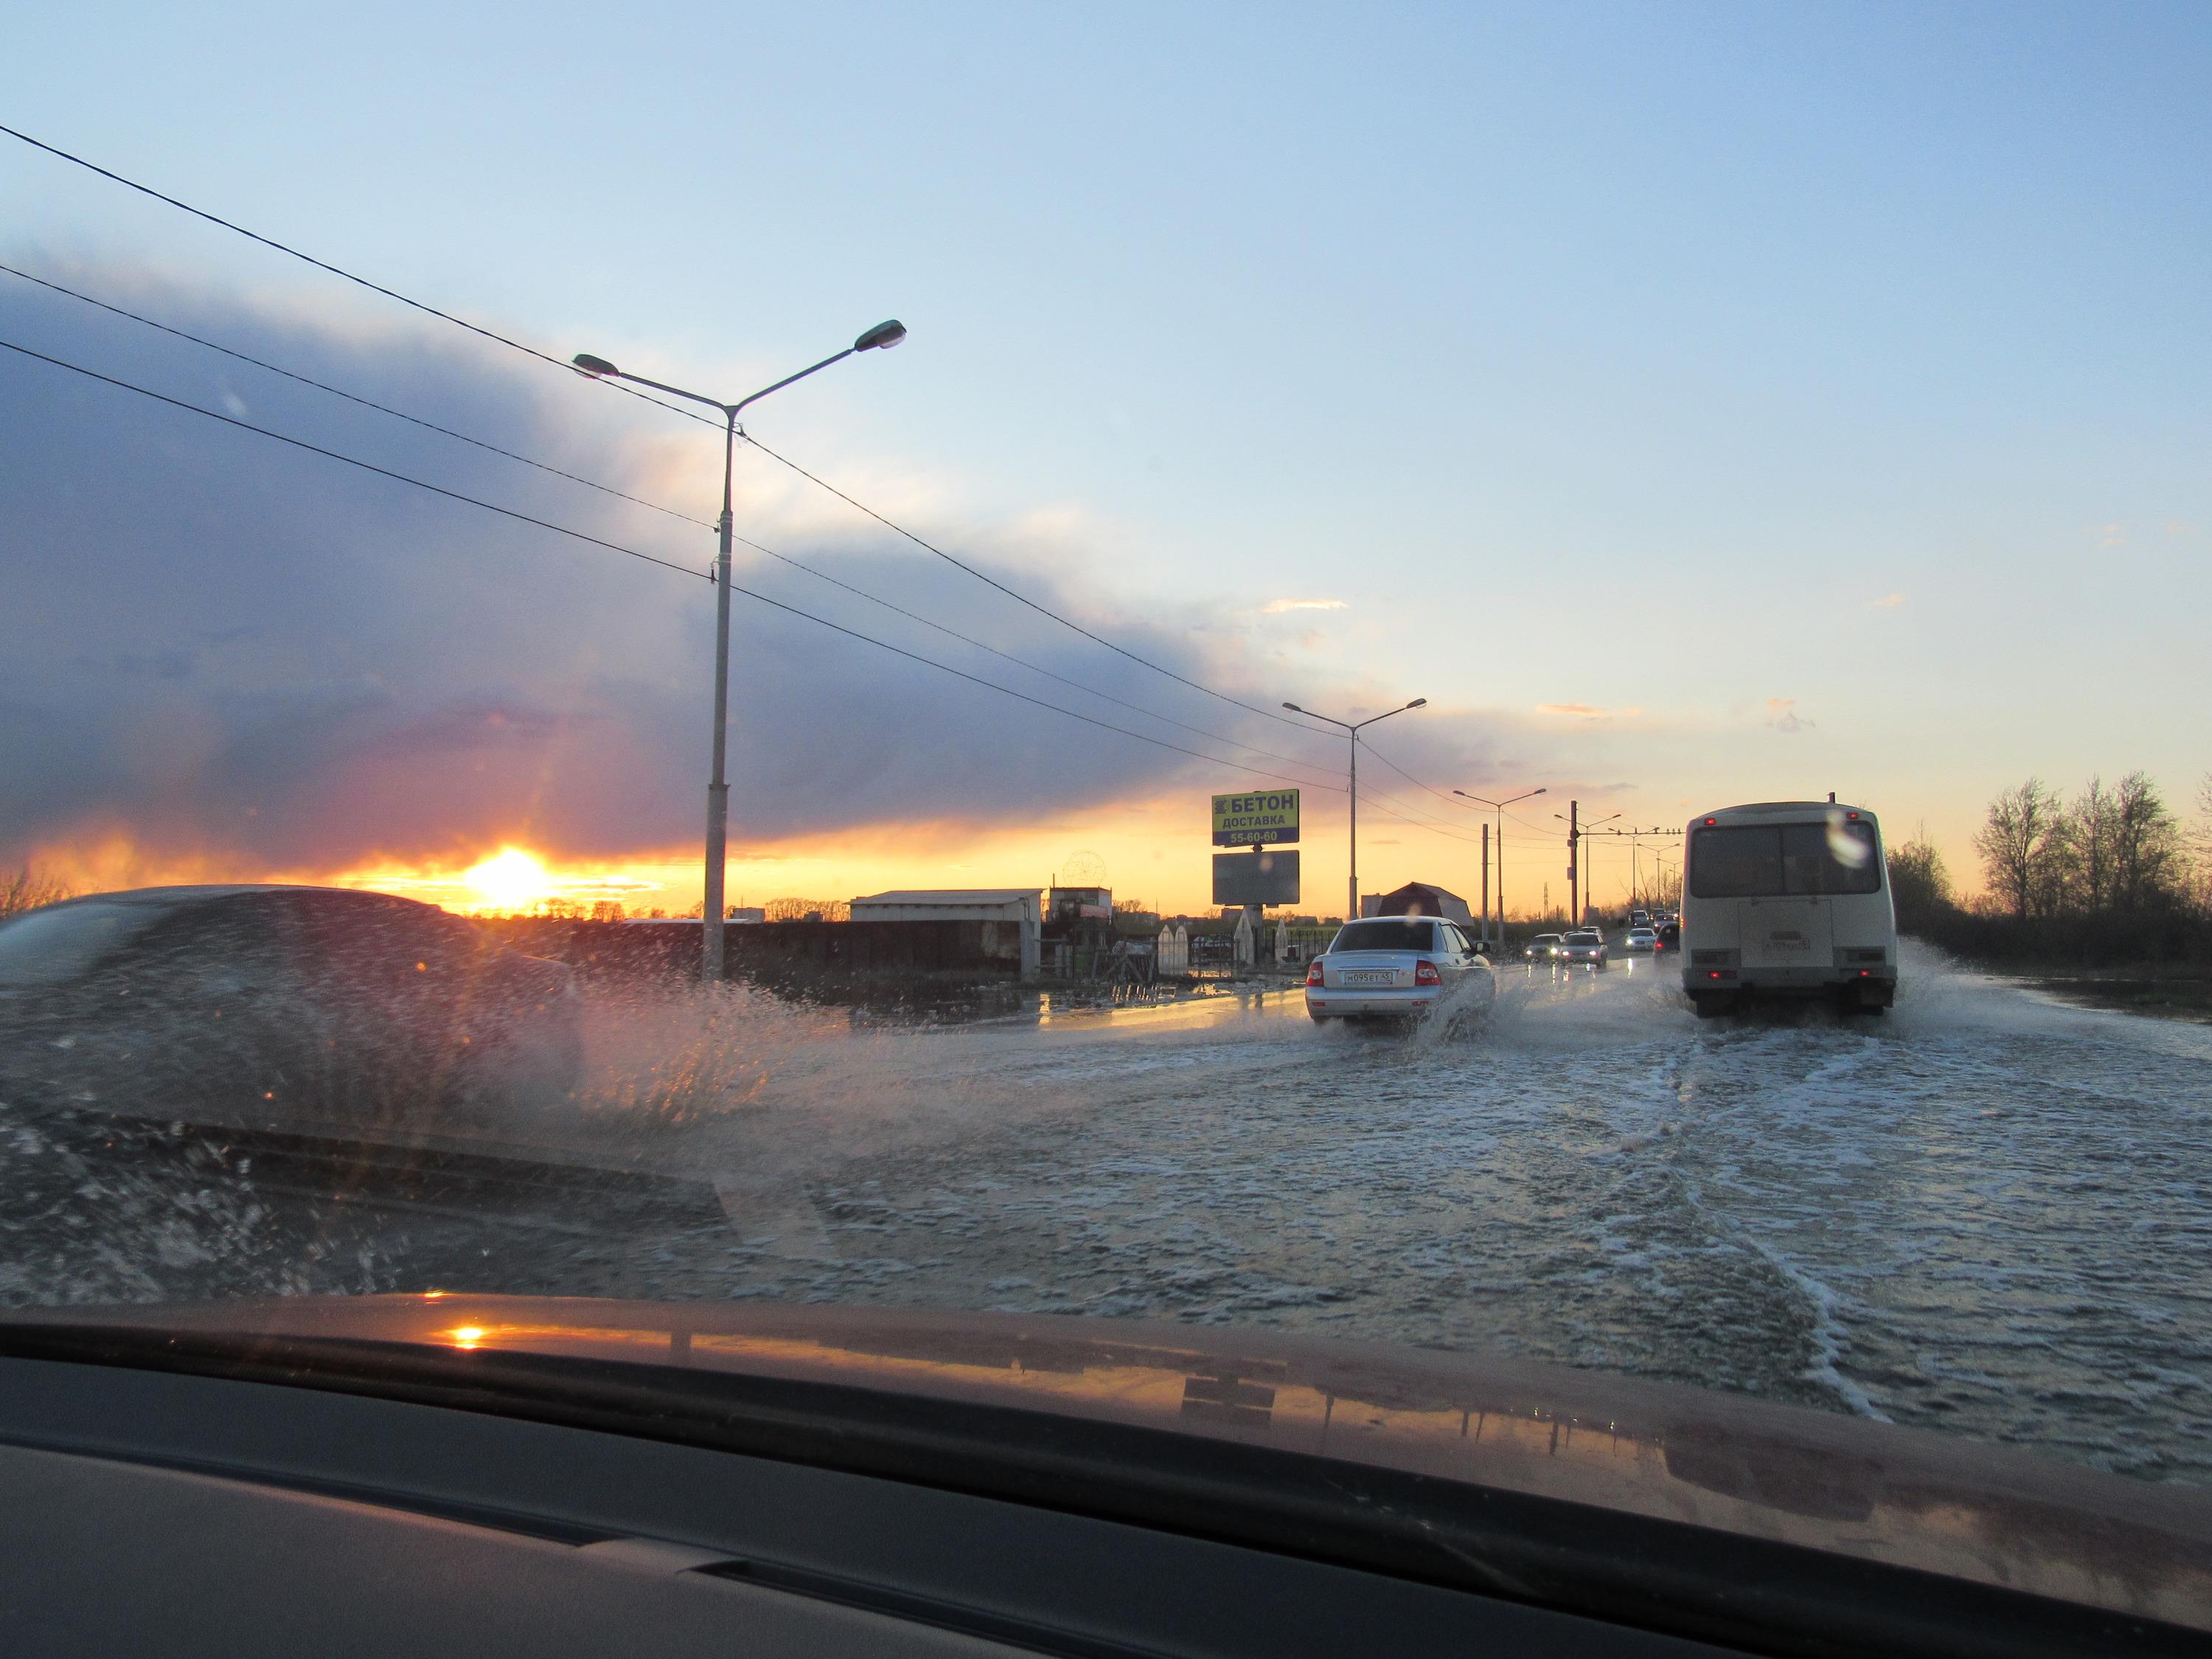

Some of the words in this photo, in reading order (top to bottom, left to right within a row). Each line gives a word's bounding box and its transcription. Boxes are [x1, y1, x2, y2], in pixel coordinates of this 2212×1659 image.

[1231, 795, 1293, 813] БЕТОН
[1222, 815, 1284, 830] ДОСТАВКА
[1231, 831, 1276, 843] 55-60-60
